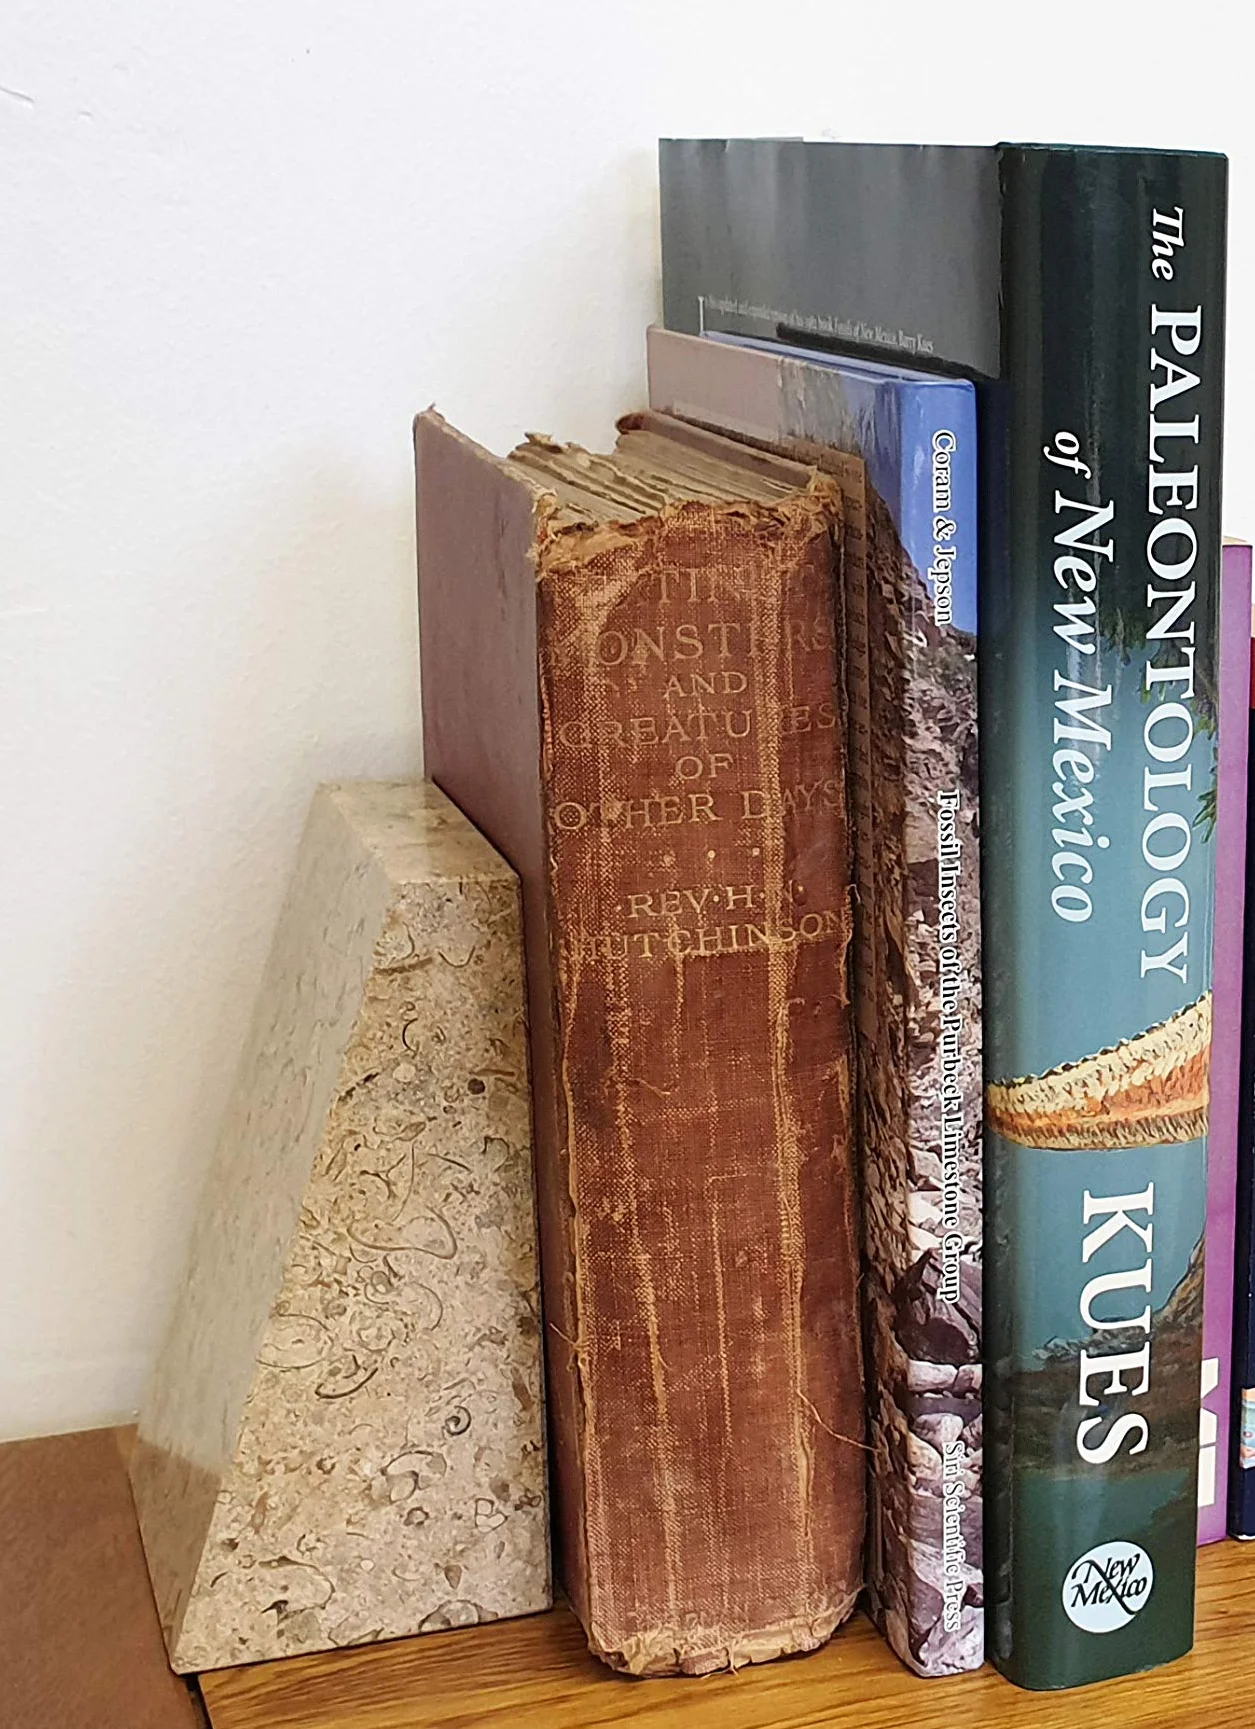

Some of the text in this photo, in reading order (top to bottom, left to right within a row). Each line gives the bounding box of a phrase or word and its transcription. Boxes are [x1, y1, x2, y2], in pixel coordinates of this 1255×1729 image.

[929, 431, 957, 625] Coram & Jepson
[1140, 206, 1202, 984] The PALEONTOLOGY
[663, 671, 748, 698] AND
[675, 753, 734, 780] OF
[1043, 430, 1114, 923] of New Mexico
[939, 791, 962, 1303] Fossil Insects of the Purbeck Limestone Group
[1076, 1181, 1154, 1465] KUES
[944, 1442, 966, 1631] Siri Scientific Press
[1070, 1577, 1147, 1611] Mexico
[1071, 1553, 1141, 1584] New
